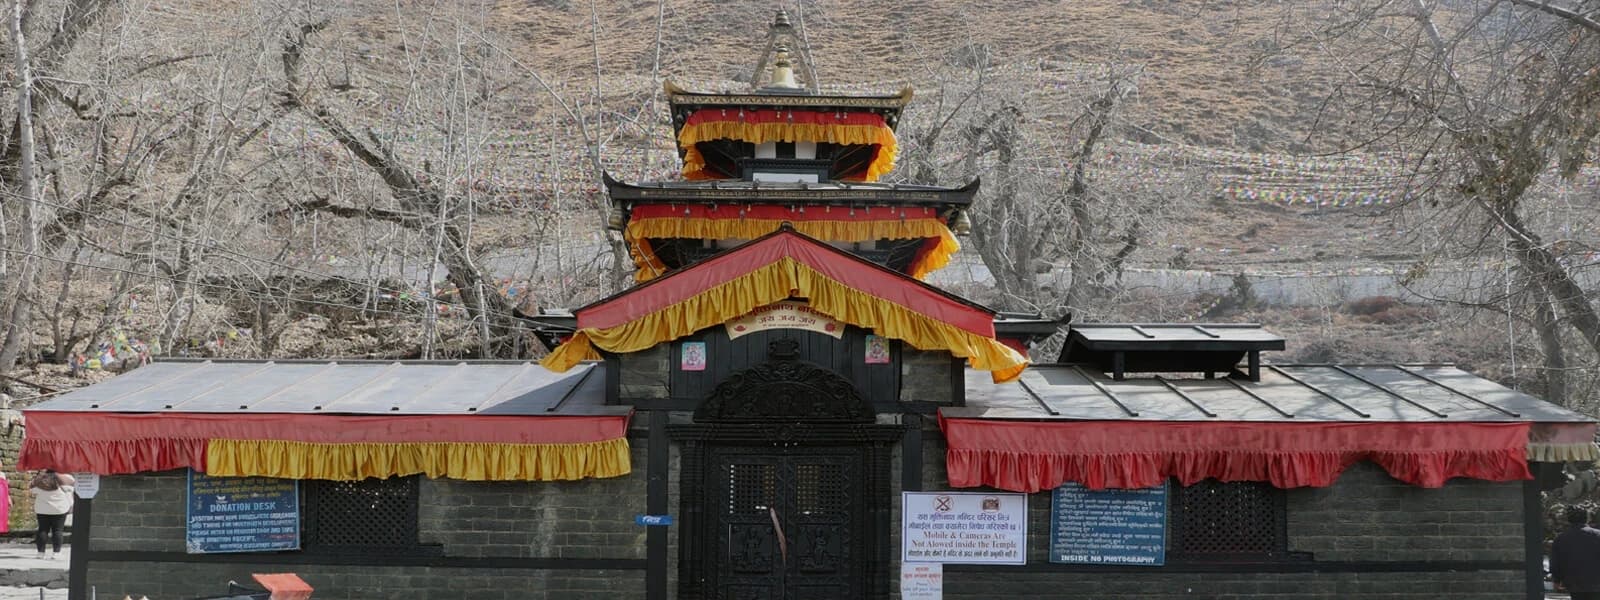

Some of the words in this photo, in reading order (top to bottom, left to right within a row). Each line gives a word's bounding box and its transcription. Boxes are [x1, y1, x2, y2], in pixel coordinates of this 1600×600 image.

[209, 503, 251, 513] DONATION
[253, 502, 276, 511] DESK
[923, 531, 948, 539] Mobile
[959, 531, 991, 539] Cameras
[912, 539, 925, 548] Not
[978, 540, 989, 548] the
[992, 540, 1016, 550] Temple
[1103, 555, 1155, 563] PHOTOGRAPHY
